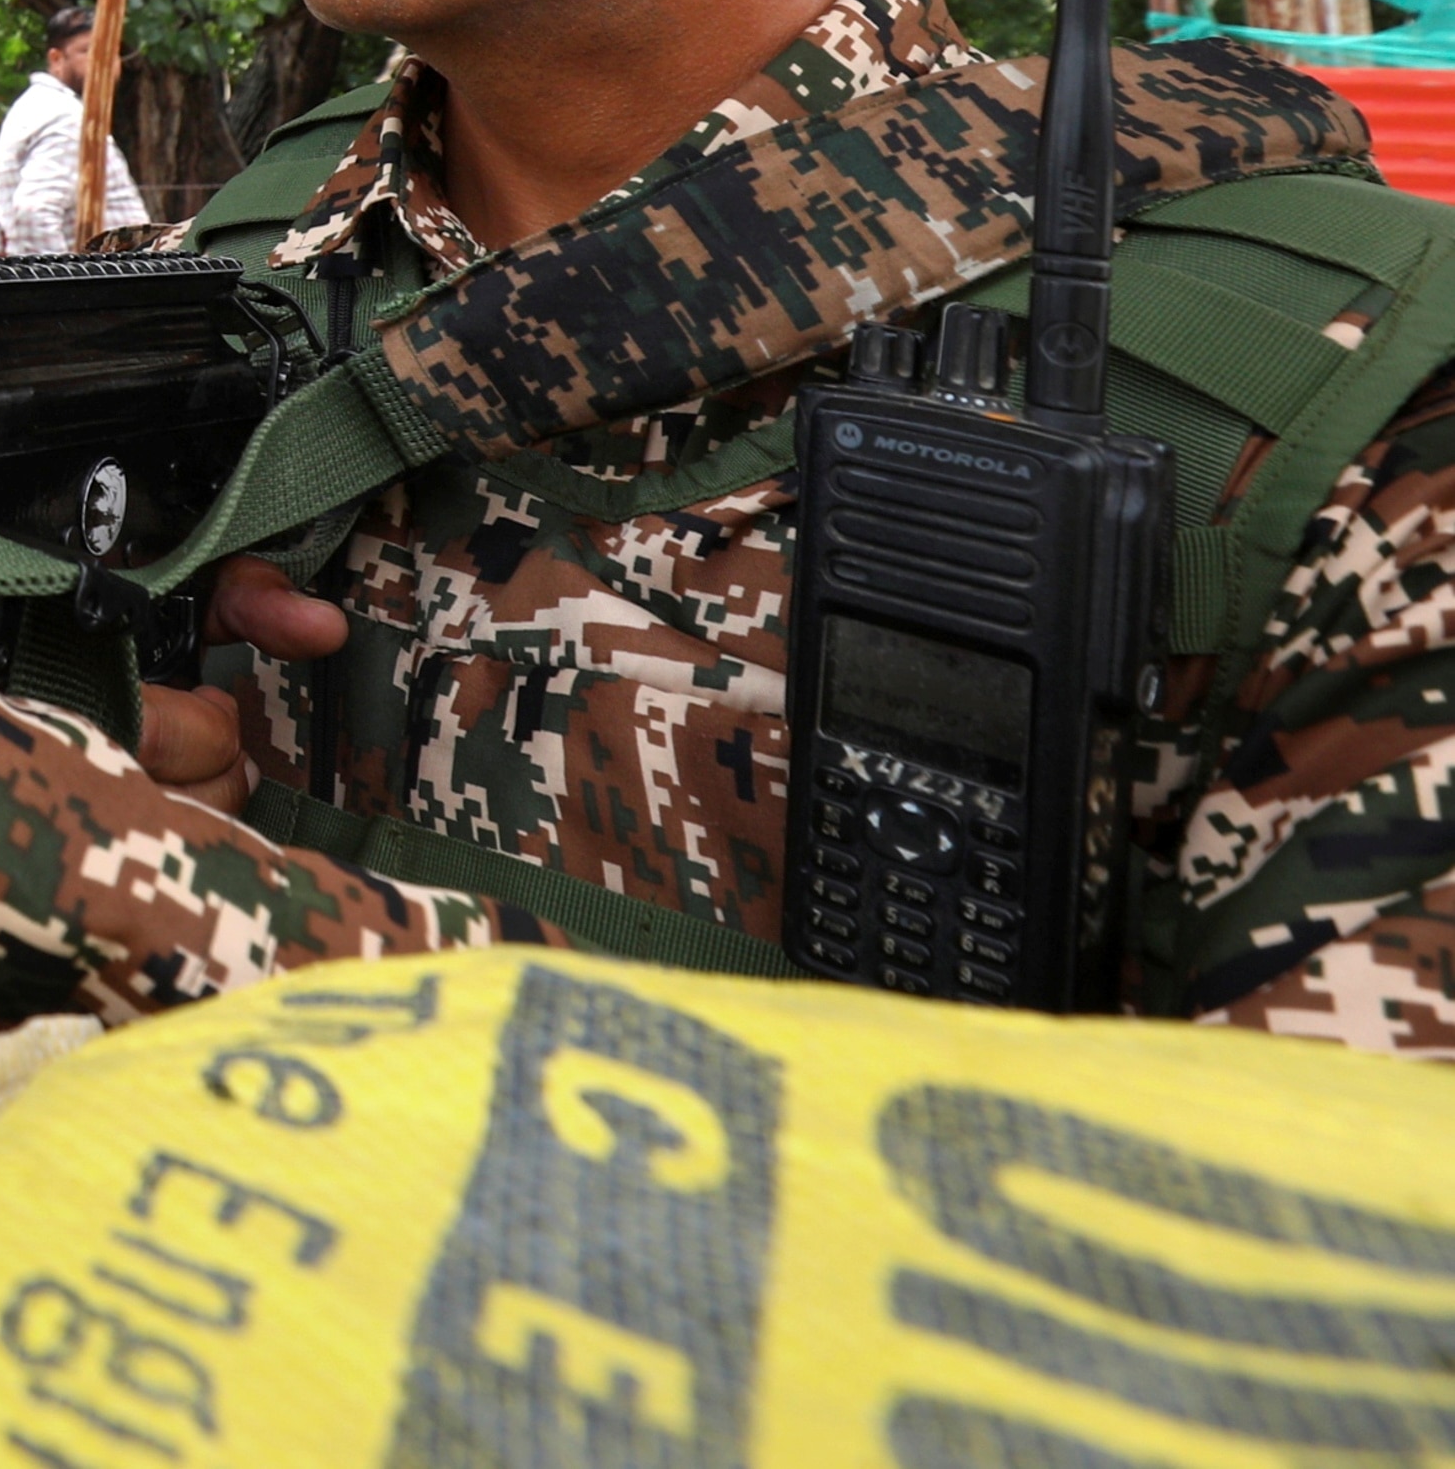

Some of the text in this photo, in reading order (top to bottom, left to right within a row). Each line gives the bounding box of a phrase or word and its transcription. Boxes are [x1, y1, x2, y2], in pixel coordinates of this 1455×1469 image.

[874, 434, 1032, 480] MOTOROLA
[886, 875, 899, 893] 2
[812, 907, 823, 924] 7
[885, 907, 899, 924] 5
[962, 899, 978, 921] 3
[960, 933, 975, 953] 6
[199, 974, 439, 1130] The
